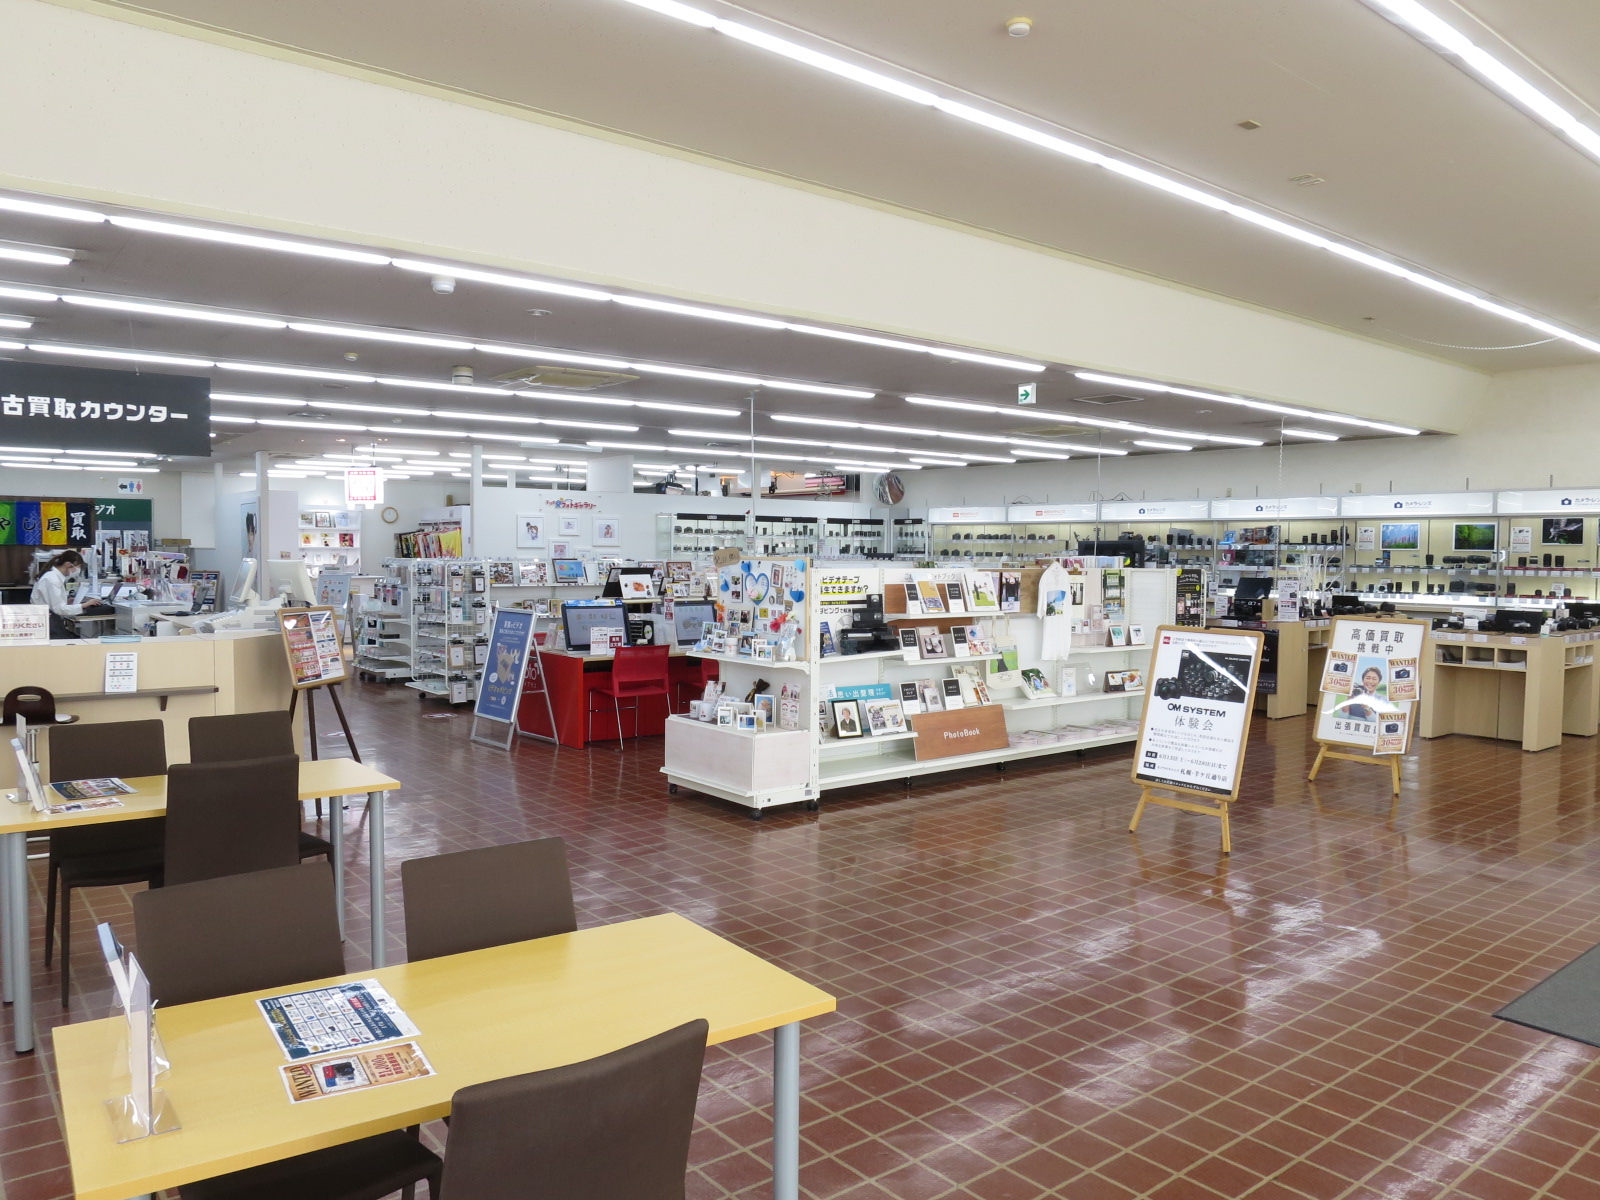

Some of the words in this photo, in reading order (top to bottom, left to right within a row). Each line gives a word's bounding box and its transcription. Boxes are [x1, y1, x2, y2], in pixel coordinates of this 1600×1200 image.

[1, 394, 188, 423] 古買取カウンター
[70, 511, 87, 540] 買取
[822, 575, 860, 584] ビデオテープ
[1351, 628, 1405, 643] 高価買取
[1357, 642, 1394, 655] 挑戦中
[837, 689, 875, 698] 思い出整理
[1167, 703, 1181, 712] OM
[1182, 705, 1226, 718] SYSTEM
[1174, 715, 1214, 731] 体験会
[943, 727, 981, 740] PhotoBook
